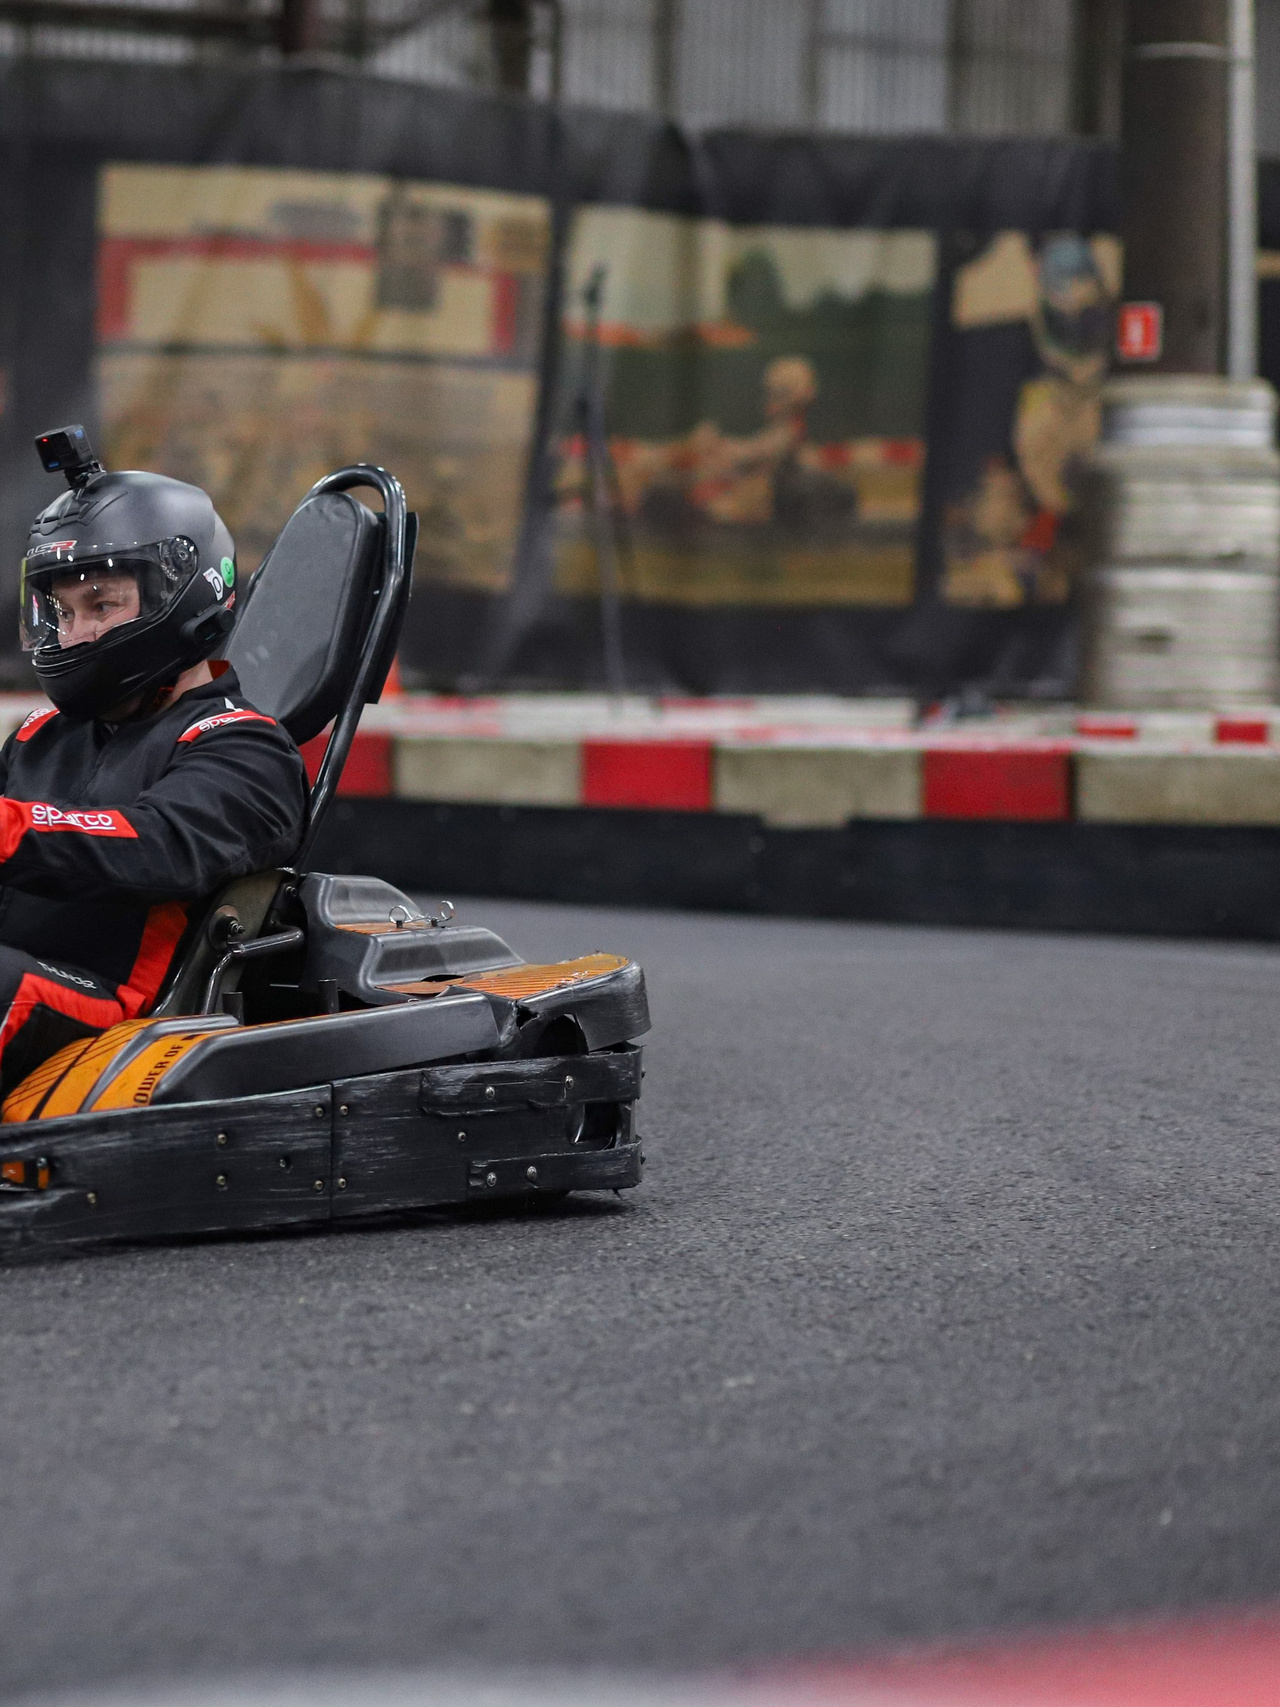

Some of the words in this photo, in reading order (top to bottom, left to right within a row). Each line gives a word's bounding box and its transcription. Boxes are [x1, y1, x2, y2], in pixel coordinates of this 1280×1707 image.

[31, 804, 117, 830] sparco
[132, 1061, 170, 1105] OWER
[164, 1044, 184, 1058] OF
